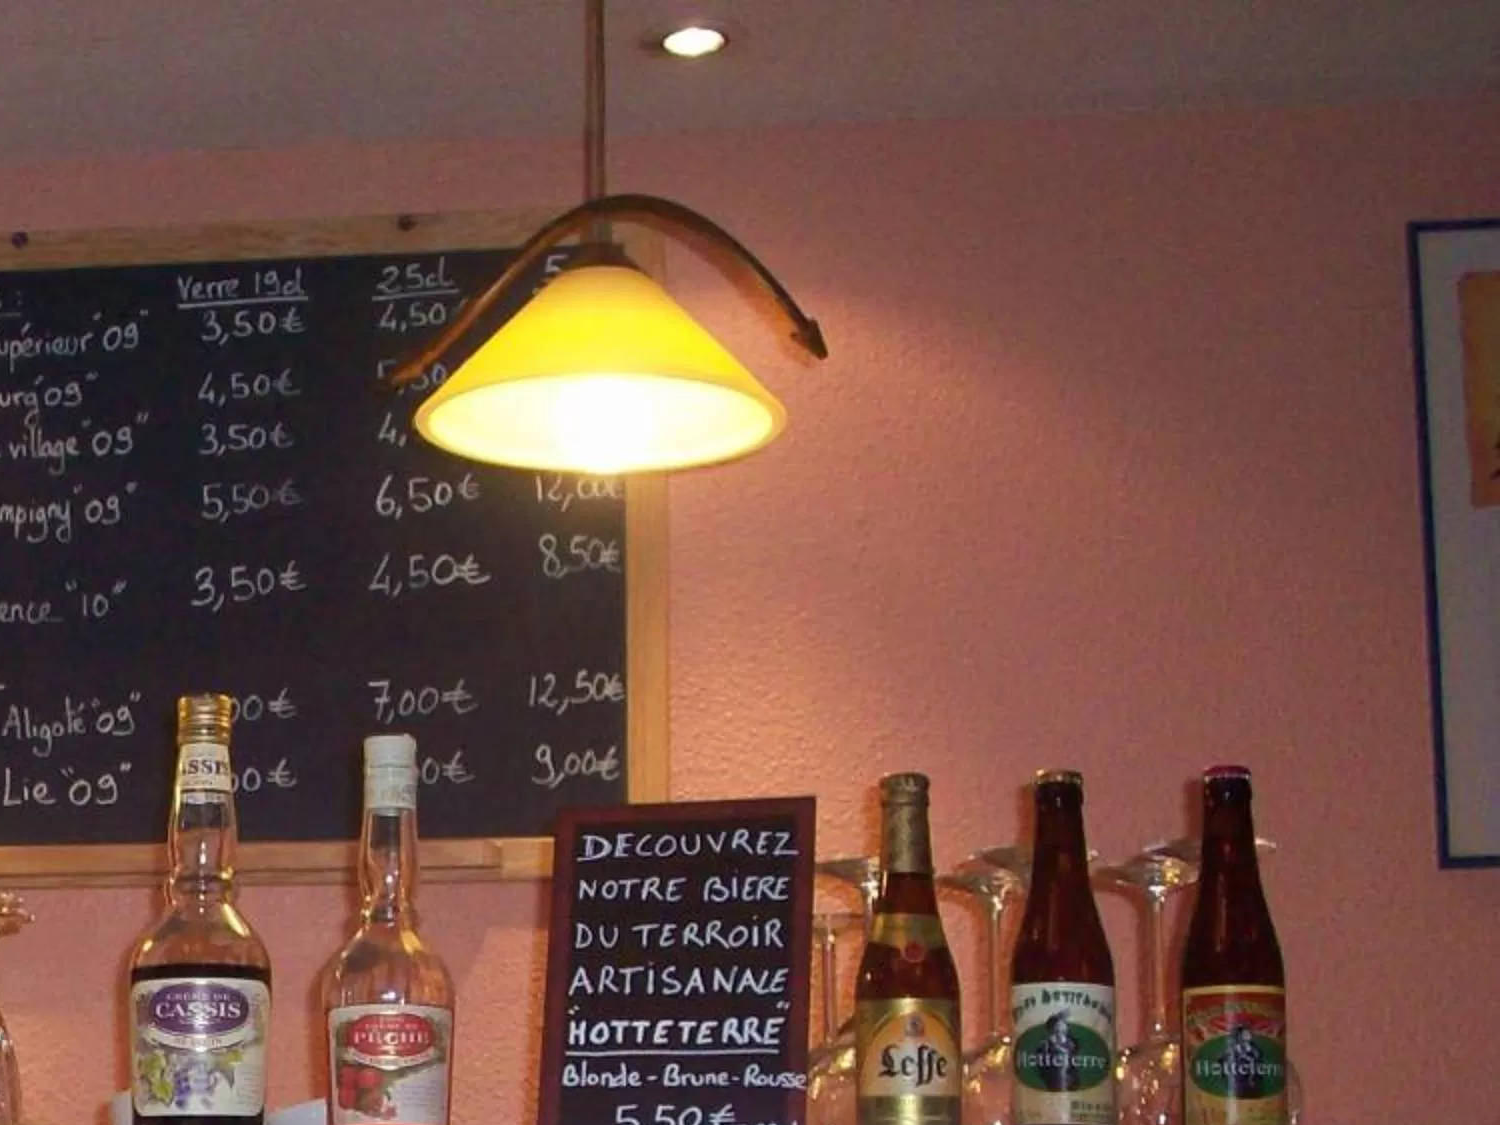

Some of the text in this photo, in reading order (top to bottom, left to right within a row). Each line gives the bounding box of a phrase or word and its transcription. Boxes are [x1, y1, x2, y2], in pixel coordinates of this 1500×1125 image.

[177, 275, 241, 299] Verre
[201, 308, 305, 346] 3,50€
[198, 370, 301, 405] 4,50€
[9, 426, 78, 476] village
[200, 422, 295, 456] 3,50€
[201, 483, 301, 524] 5,50€
[376, 473, 481, 520] 6,50€
[368, 553, 493, 599] 4,50€
[538, 533, 622, 579] 8,50€
[190, 560, 307, 614] 3,50€
[367, 678, 479, 725] 7,00€
[527, 669, 627, 716] 12,50€
[0, 697, 87, 758] Aligoté
[531, 743, 620, 791] 9,00€
[3, 768, 57, 809] Lie
[577, 828, 799, 861] DECOUVREZ
[578, 876, 688, 902] NOTRE
[574, 915, 784, 949] DU TERROIR
[568, 962, 790, 997] ARTISANALE
[155, 1001, 242, 1020] CASSIS
[877, 1043, 949, 1088] Leffe
